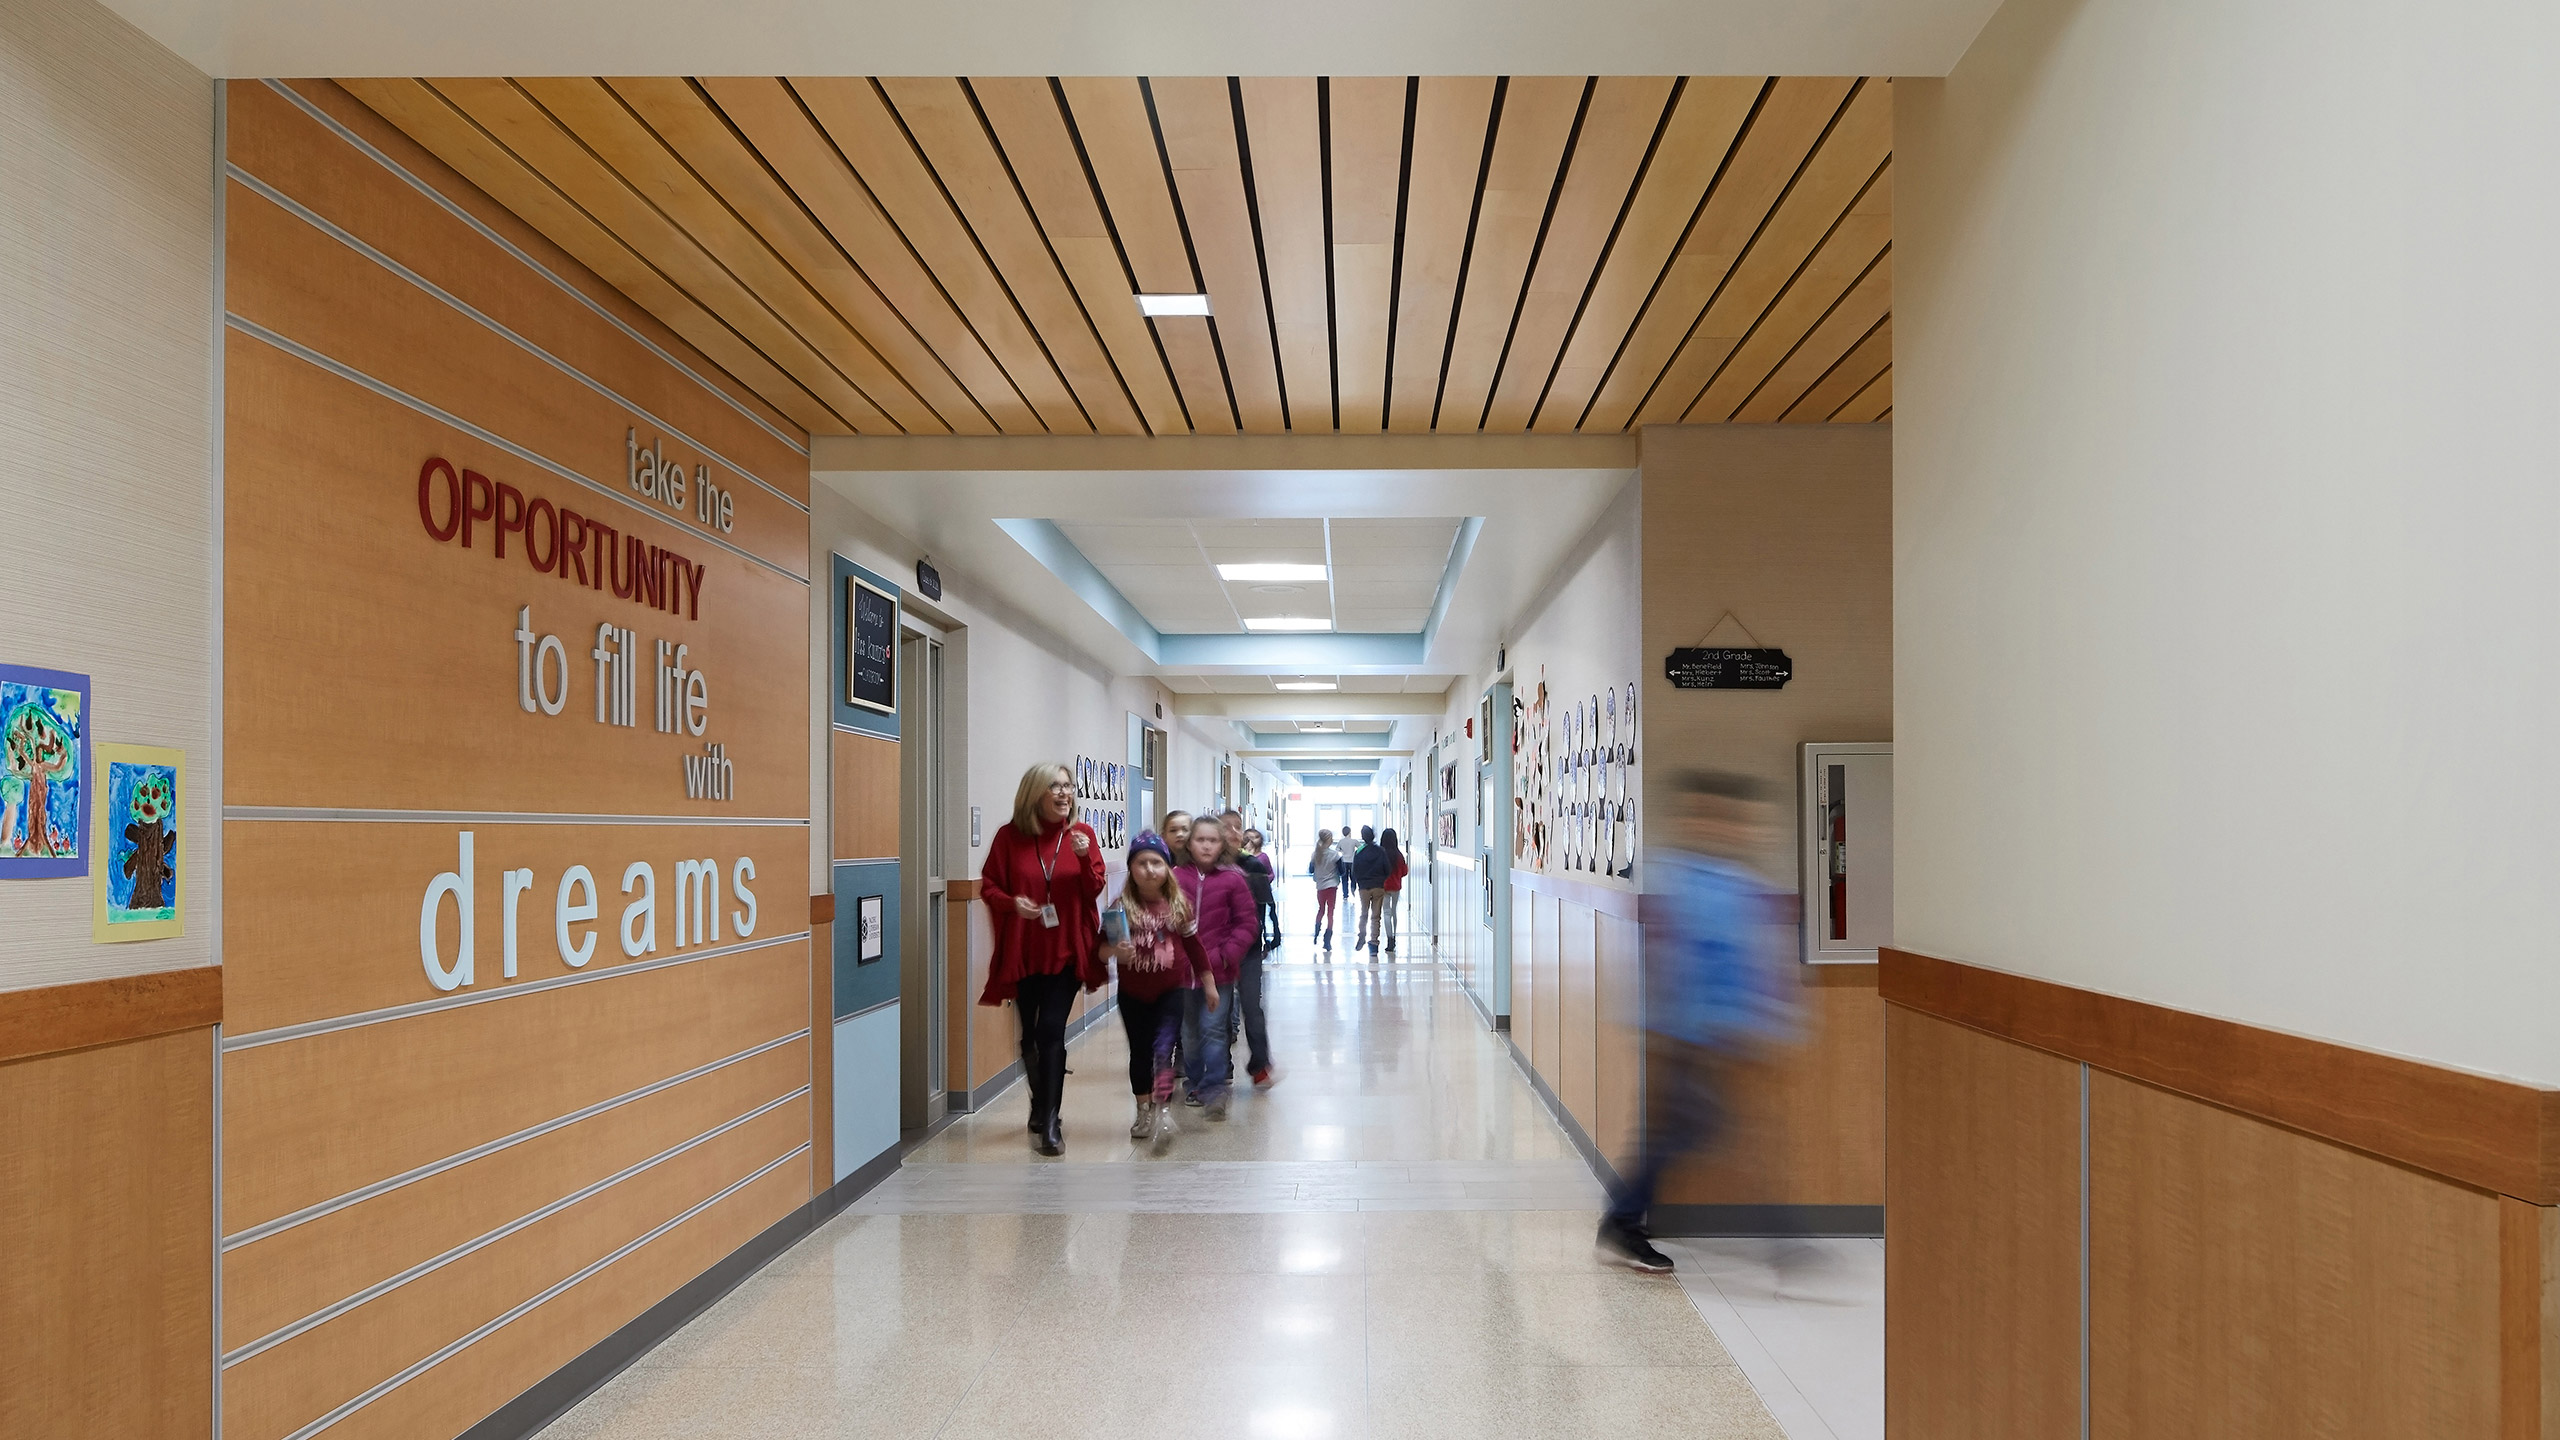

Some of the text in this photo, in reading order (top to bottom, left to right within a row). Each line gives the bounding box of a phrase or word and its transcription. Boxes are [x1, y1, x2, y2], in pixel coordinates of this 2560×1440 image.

[417, 456, 706, 622] OPPORTUNITY
[625, 425, 735, 535] take the
[514, 603, 709, 737] to fill life
[1702, 650, 1753, 661] 2nd Grade
[683, 741, 734, 801] with
[419, 830, 758, 992] dreams
